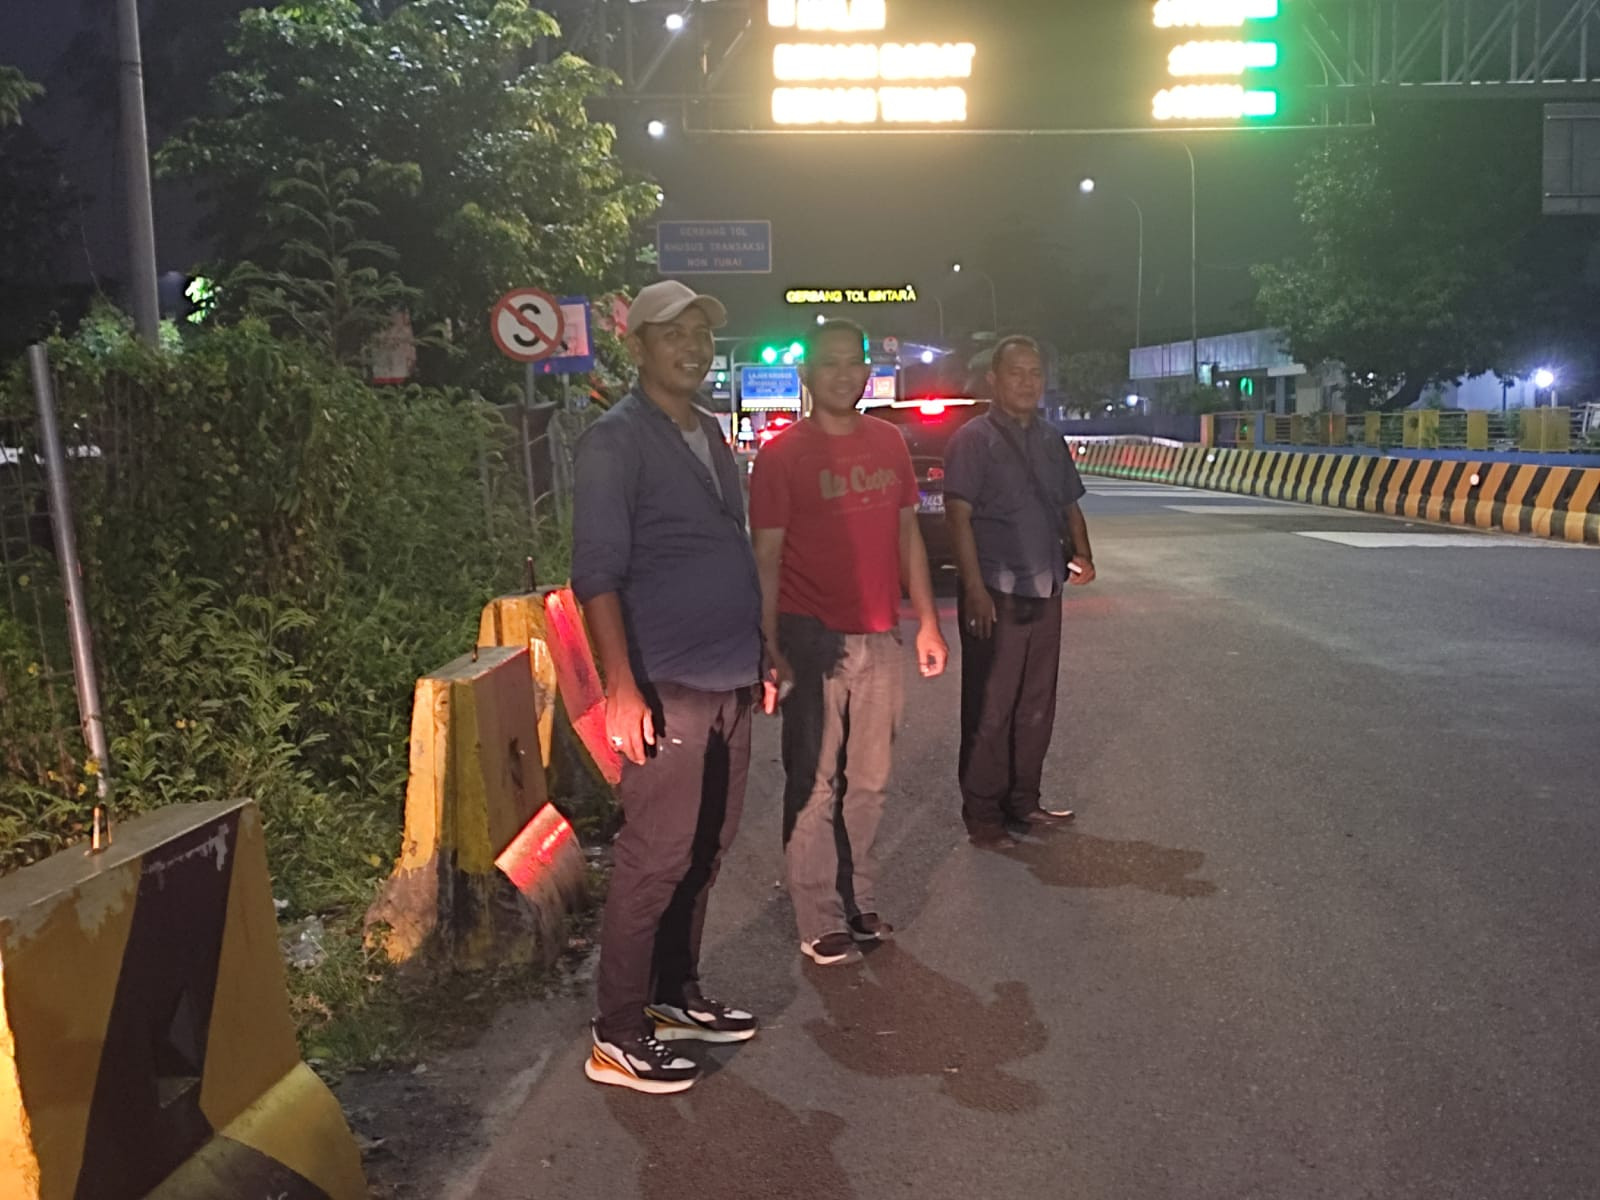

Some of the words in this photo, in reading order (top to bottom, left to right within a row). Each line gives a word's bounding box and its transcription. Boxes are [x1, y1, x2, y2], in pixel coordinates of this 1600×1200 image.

[730, 226, 748, 237] TOL
[664, 242, 704, 252] KHUSUS
[710, 242, 765, 252] TRANSAKSI
[687, 257, 709, 267] NON
[786, 289, 842, 302] GERBANG
[845, 290, 867, 302] TOL
